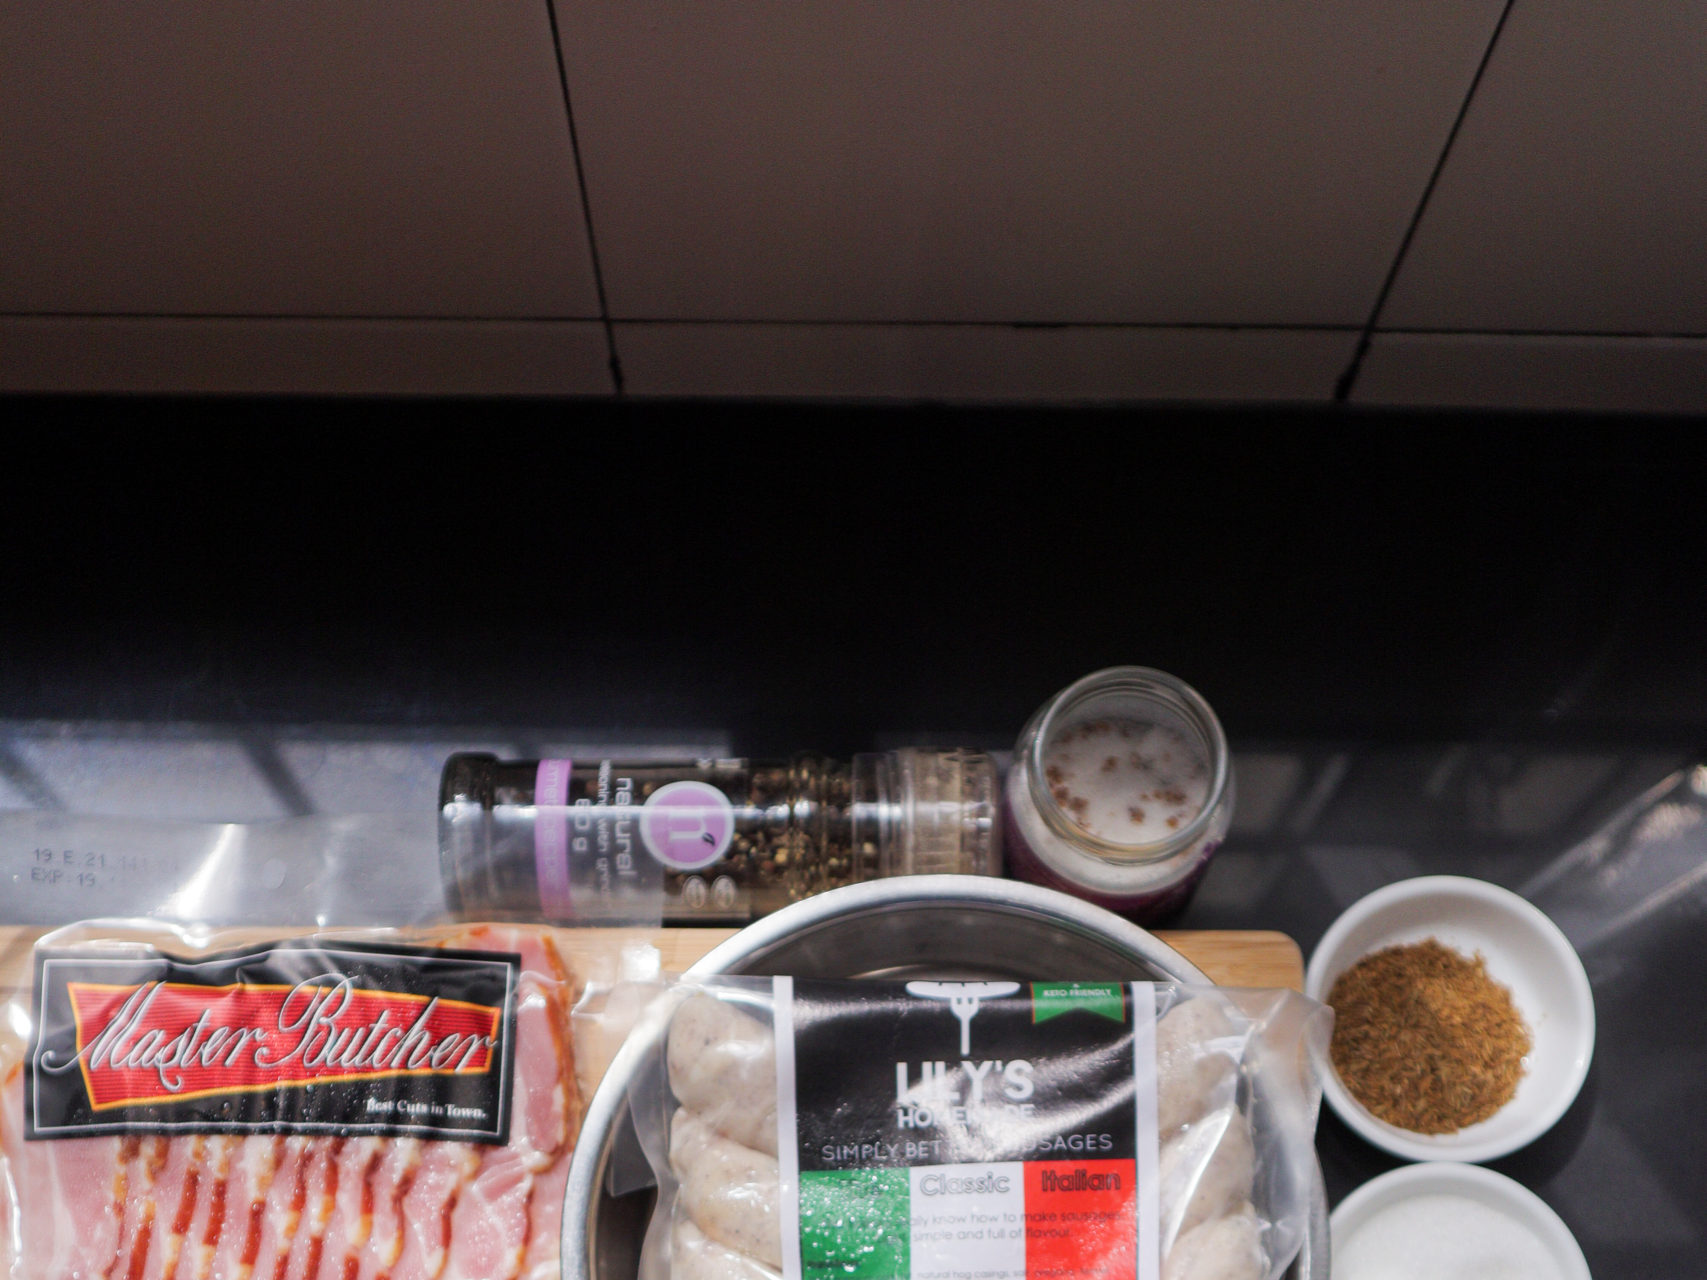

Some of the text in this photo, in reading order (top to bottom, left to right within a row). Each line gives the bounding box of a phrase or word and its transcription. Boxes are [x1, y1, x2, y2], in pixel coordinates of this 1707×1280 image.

[1069, 988, 1112, 998] FRIENDLY
[41, 973, 498, 1092] Master Butcher
[896, 1060, 1035, 1104] LILY'S
[367, 1097, 393, 1112] Best
[397, 1100, 428, 1114] Cuts
[431, 1102, 443, 1115] in
[822, 1141, 900, 1162] SIMPLY
[919, 1171, 1011, 1197] Classic
[1041, 1168, 1122, 1192] Italian
[932, 1214, 966, 1226] know
[970, 1212, 998, 1225] how
[1003, 1212, 1017, 1222] to
[1021, 1211, 1057, 1223] make
[912, 1230, 953, 1243] simple
[956, 1228, 984, 1240] and
[987, 1228, 1005, 1240] full
[1008, 1227, 1023, 1239] of
